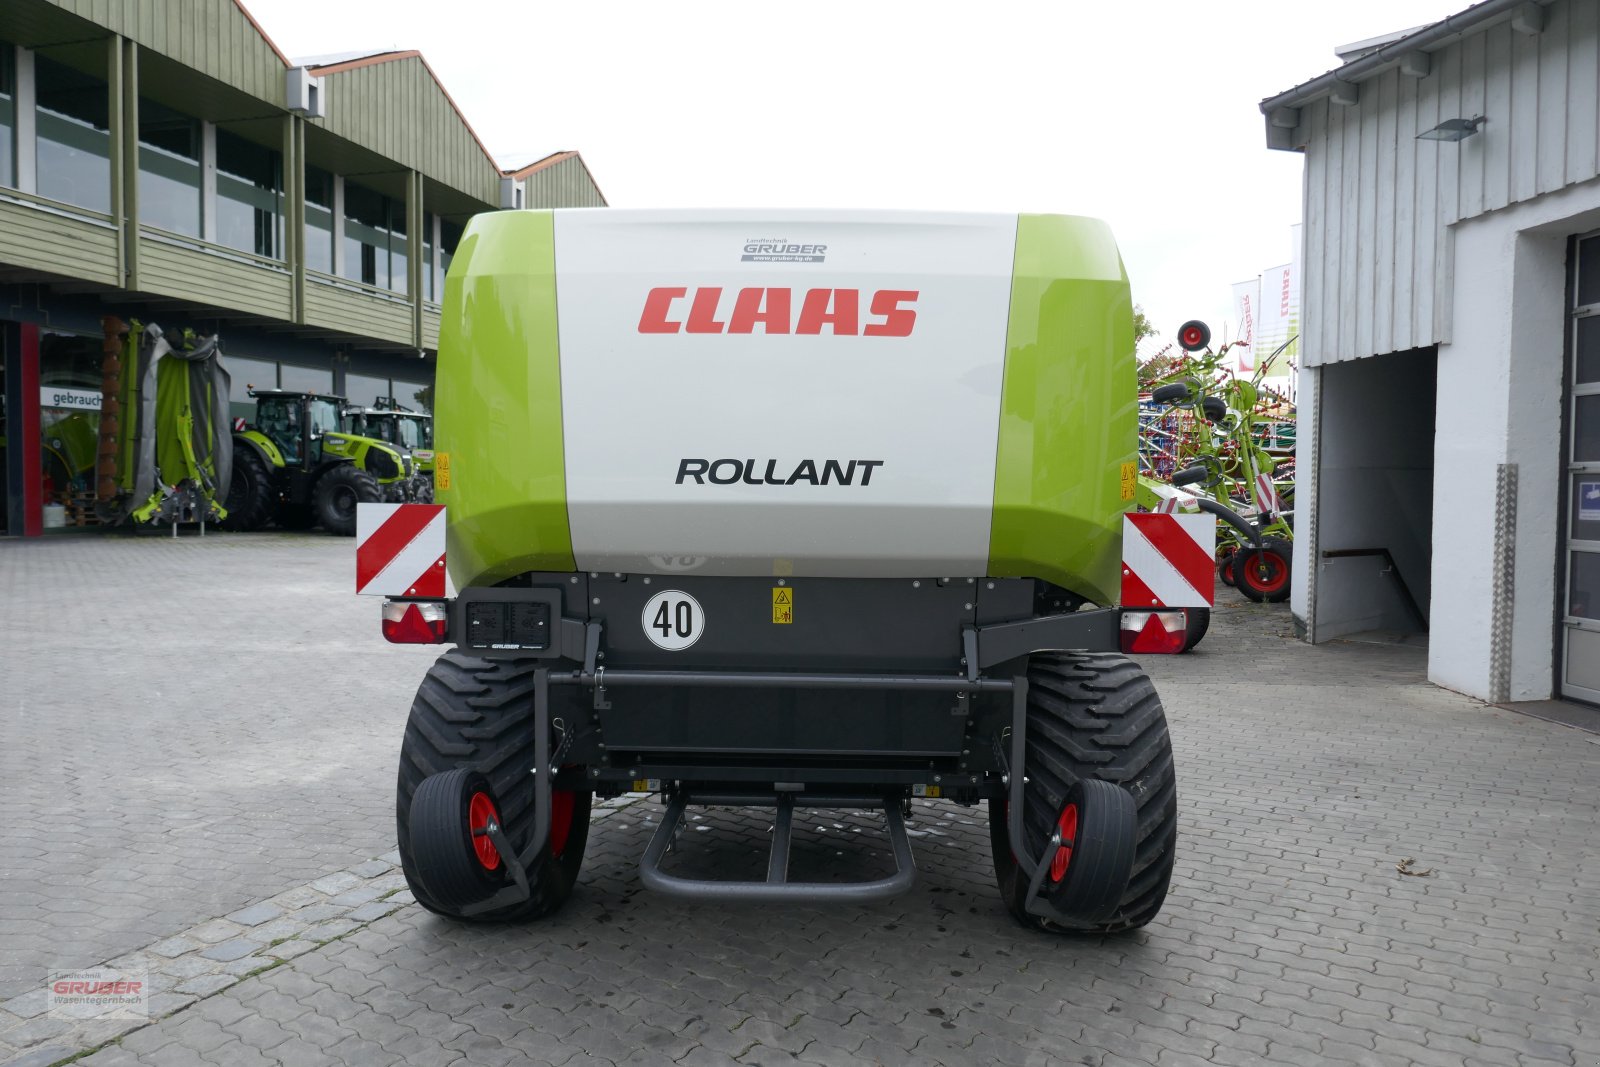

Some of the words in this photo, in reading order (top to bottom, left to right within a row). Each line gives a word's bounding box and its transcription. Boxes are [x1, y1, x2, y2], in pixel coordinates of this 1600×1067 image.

[743, 244, 828, 254] GRUBER
[637, 286, 920, 338] CLAAS
[674, 458, 885, 487] ROLLANT
[652, 600, 692, 638] 40
